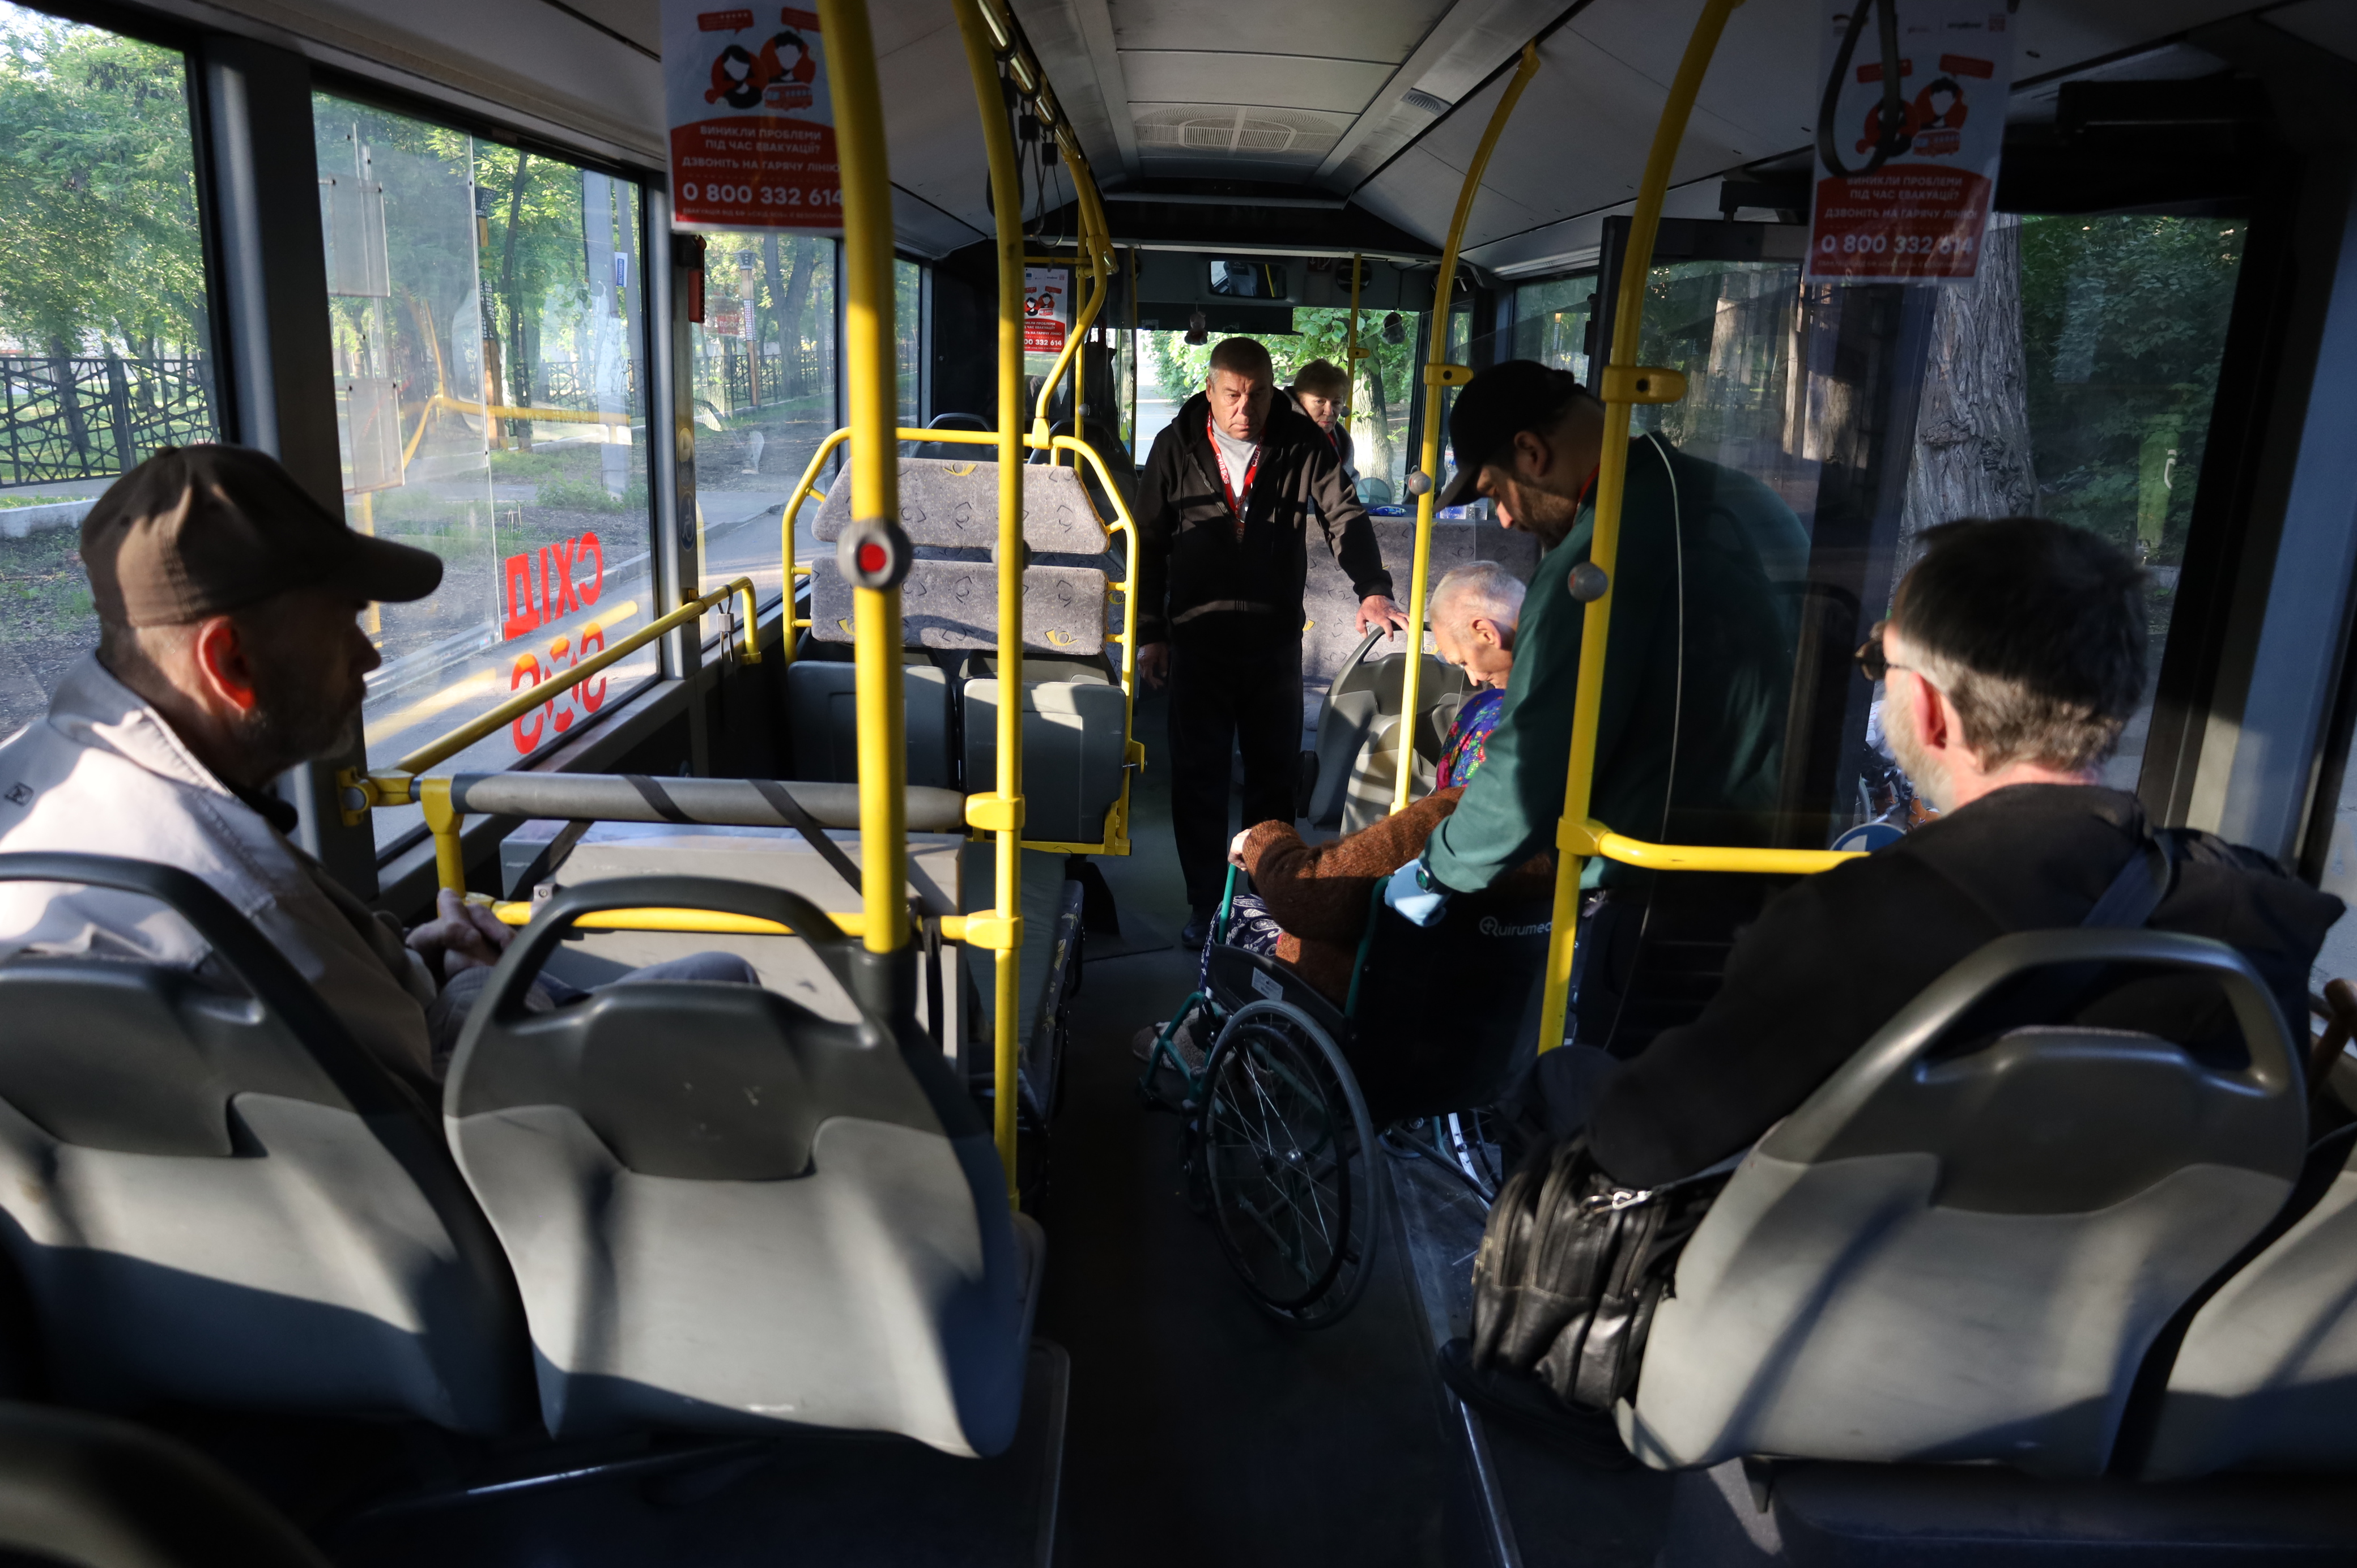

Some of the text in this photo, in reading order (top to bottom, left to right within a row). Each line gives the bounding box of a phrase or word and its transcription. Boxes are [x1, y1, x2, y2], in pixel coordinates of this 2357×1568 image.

[700, 125, 822, 140] ВИНИКЛИ ПРОБЛЕМИ
[705, 139, 726, 150] ПІД
[729, 140, 752, 151] ЧАС
[682, 156, 739, 168] ДЗВОНІТЬ
[742, 160, 759, 169] НА
[762, 160, 803, 171] ГАРЯЧУ
[1903, 176, 1963, 186] ПРОБЛЕМИ
[682, 182, 699, 201] 0
[706, 183, 752, 204] 800
[760, 186, 801, 205] 332
[1850, 189, 1869, 200] ПІД
[1873, 190, 1895, 199] ЧАС
[1824, 208, 1879, 219] ДЗВОНІТЬ
[1883, 209, 1897, 218] НА
[1900, 208, 1941, 219] ГАРЯЧУ
[1821, 233, 1973, 254] 0 800 332 614
